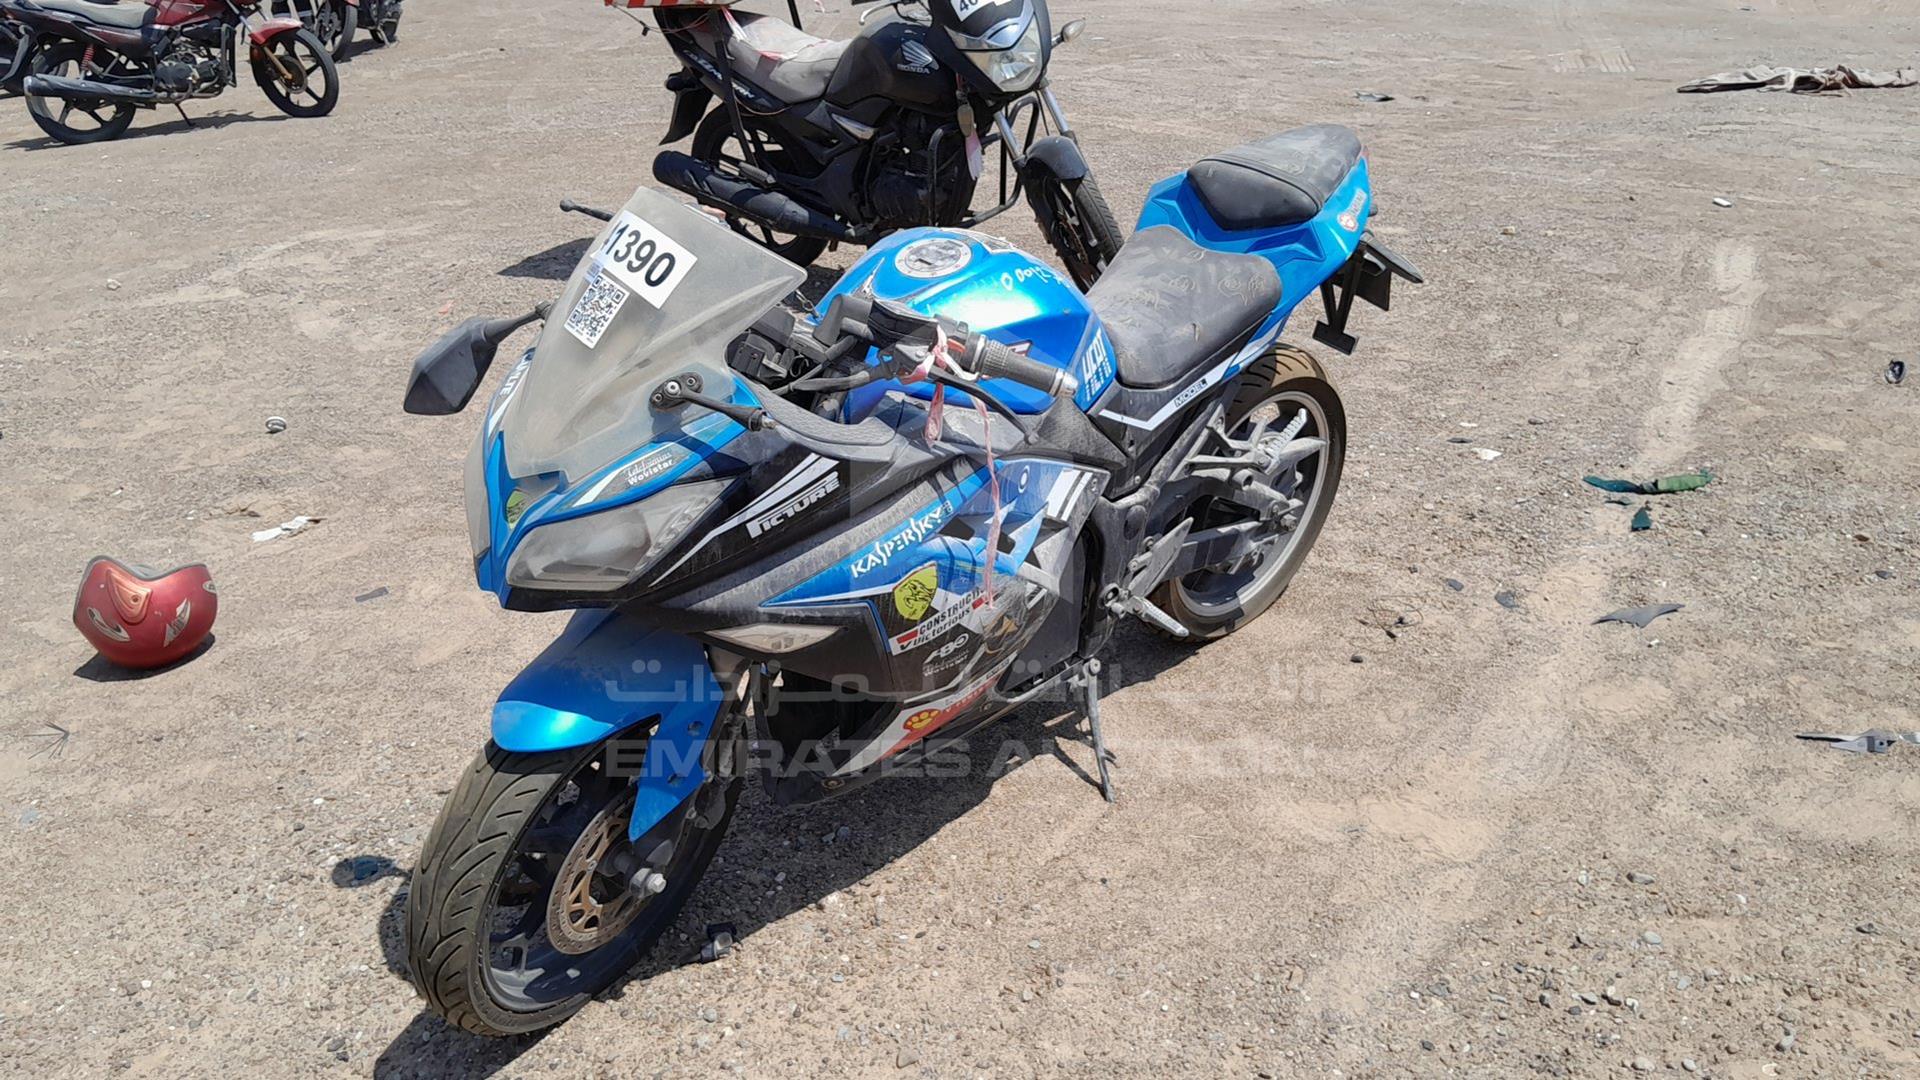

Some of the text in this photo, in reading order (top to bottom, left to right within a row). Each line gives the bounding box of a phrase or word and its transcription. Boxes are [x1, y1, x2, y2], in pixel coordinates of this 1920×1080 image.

[897, 64, 930, 74] HONDA
[1175, 379, 1208, 408] MODEL
[851, 507, 942, 578] KASPERSKY
